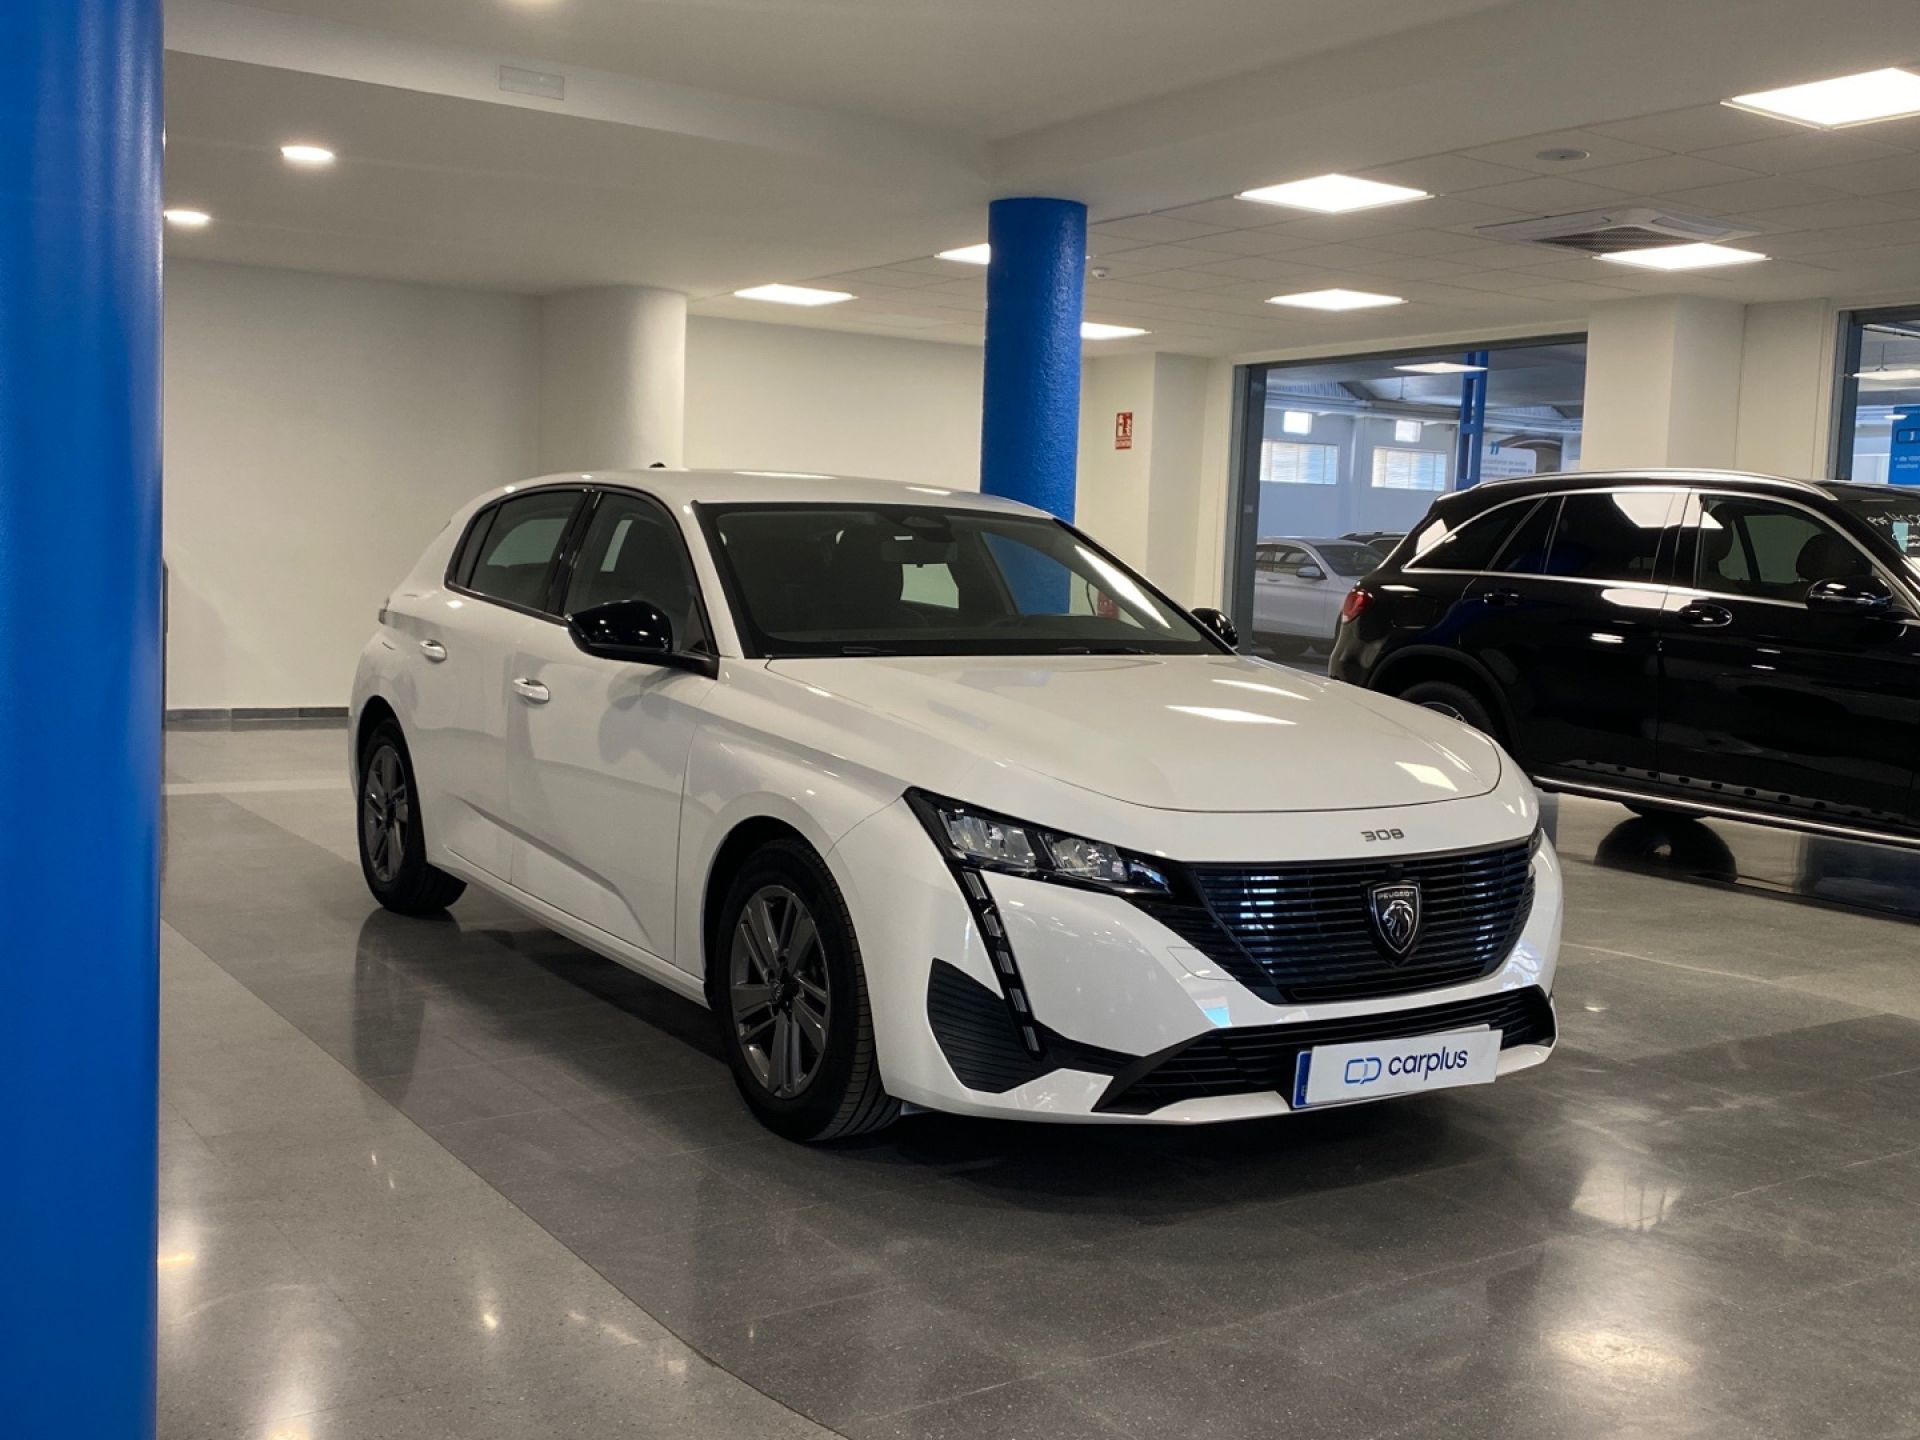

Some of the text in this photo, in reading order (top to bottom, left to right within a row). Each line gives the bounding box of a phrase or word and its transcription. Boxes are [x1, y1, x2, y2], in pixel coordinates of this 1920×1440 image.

[1361, 828, 1404, 842] 308
[1377, 890, 1414, 900] PEUGEOT
[1388, 1046, 1468, 1081] carplus
